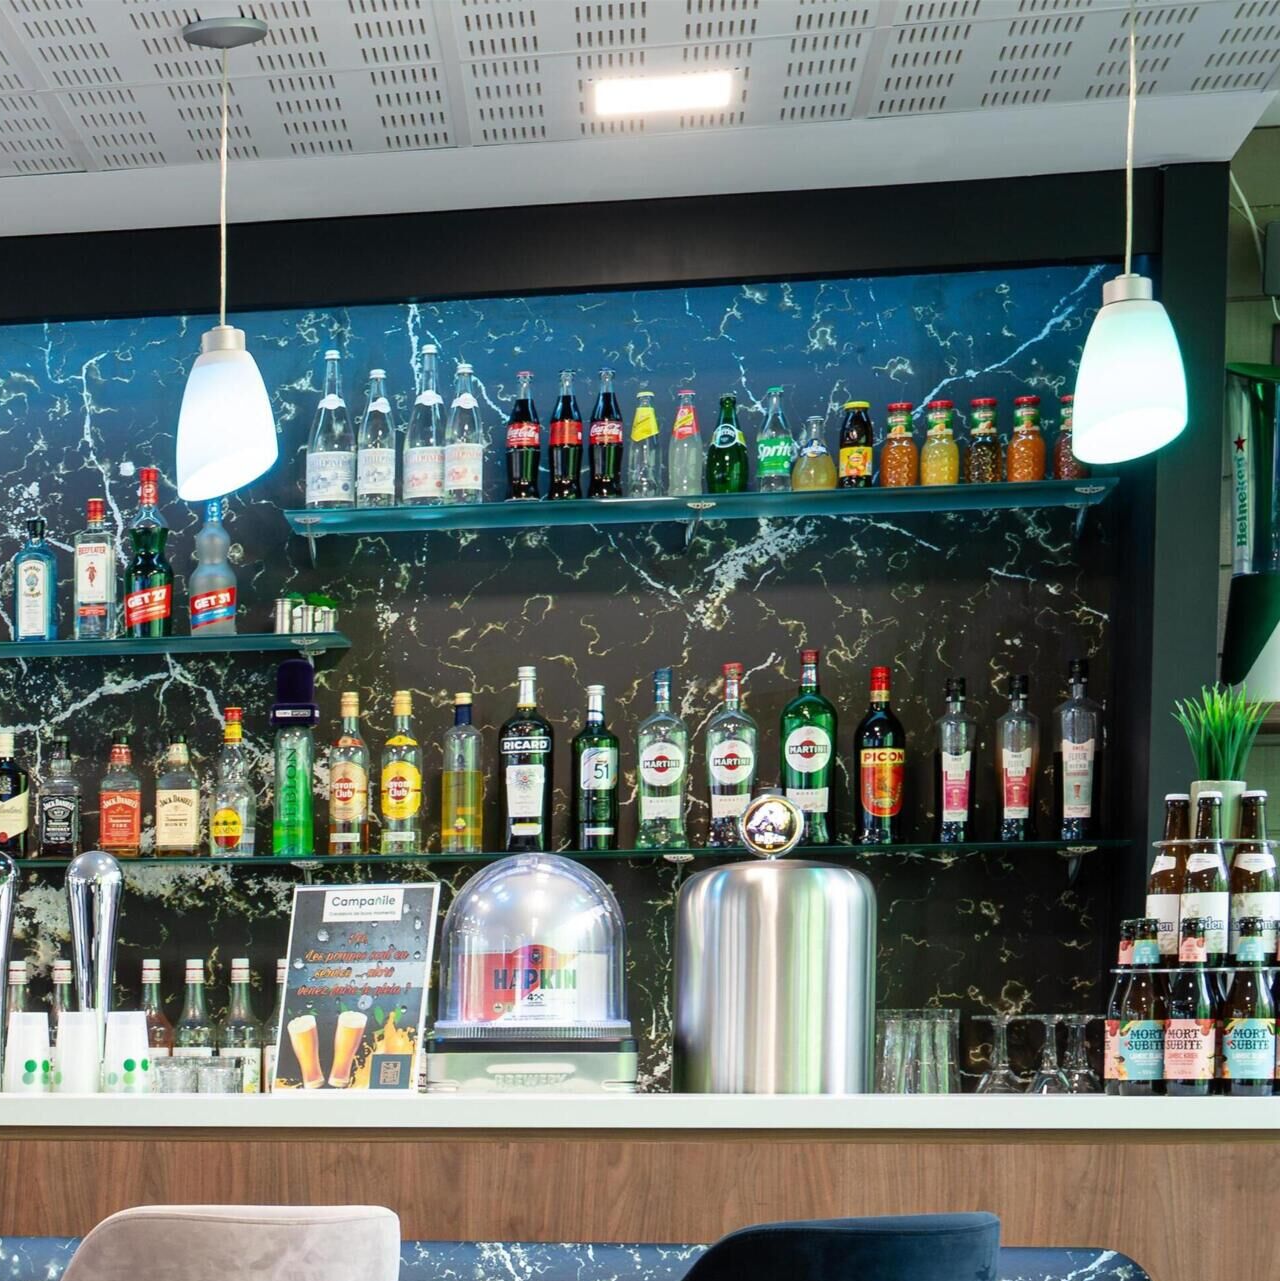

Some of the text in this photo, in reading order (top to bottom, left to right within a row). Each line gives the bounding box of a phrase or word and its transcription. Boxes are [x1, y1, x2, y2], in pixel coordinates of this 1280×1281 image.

[127, 592, 151, 608] GET
[194, 595, 217, 610] GET
[503, 740, 548, 750] RICARD
[789, 744, 828, 754] MARTINI
[713, 757, 751, 767] MARTINI
[863, 751, 904, 762] PICON
[644, 760, 680, 769] MARTINI
[593, 764, 610, 780] 51
[335, 788, 353, 799] Club
[389, 787, 408, 798] Club
[494, 968, 576, 990] HAPKIN
[1129, 1028, 1164, 1040] MORT
[1167, 1028, 1200, 1040] MORT
[1233, 1028, 1268, 1039] MORT
[1166, 1039, 1203, 1050] SUBITE
[1231, 1039, 1270, 1050] SUBITE
